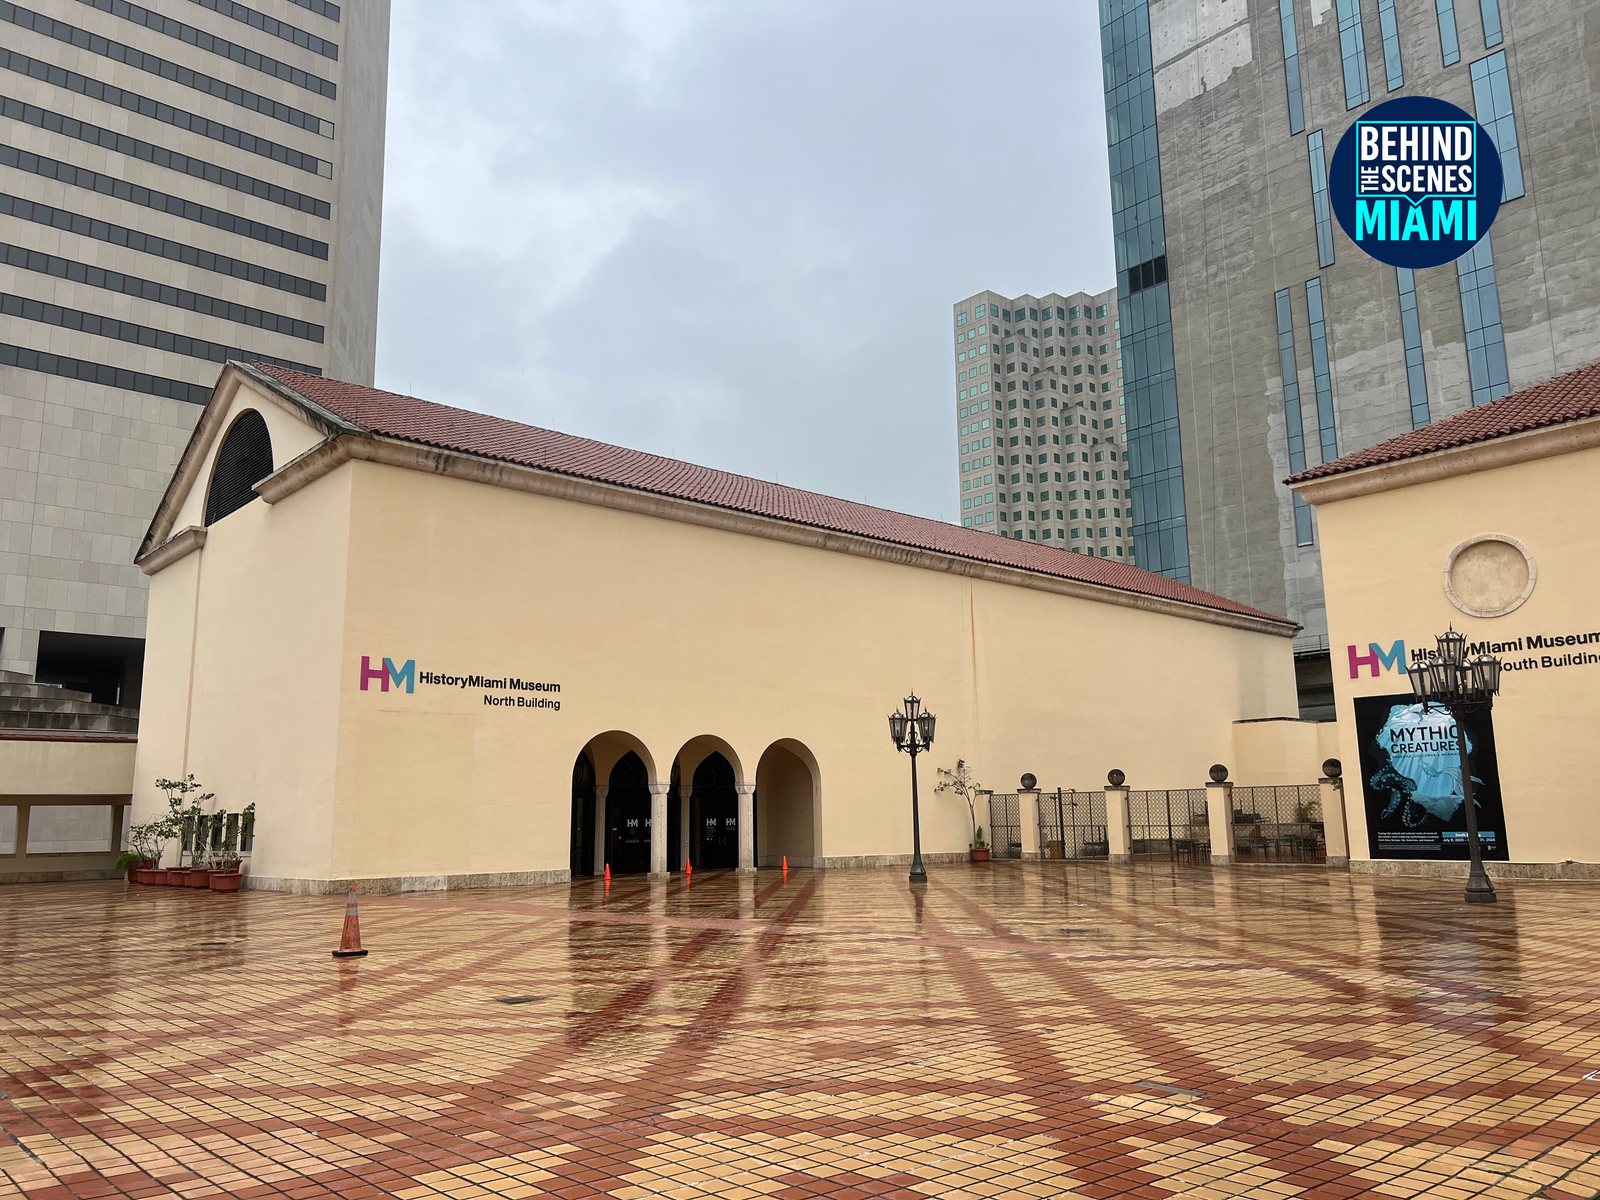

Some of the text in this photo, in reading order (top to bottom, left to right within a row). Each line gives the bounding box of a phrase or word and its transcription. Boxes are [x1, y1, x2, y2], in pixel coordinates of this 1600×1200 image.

[1347, 639, 1406, 679] HM
[1411, 637, 1523, 662] HisyMiami
[1541, 652, 1600, 668] Buildin
[360, 655, 561, 694] HM HistoryMiami Museum
[484, 695, 561, 711] North Building
[627, 818, 639, 828] HM
